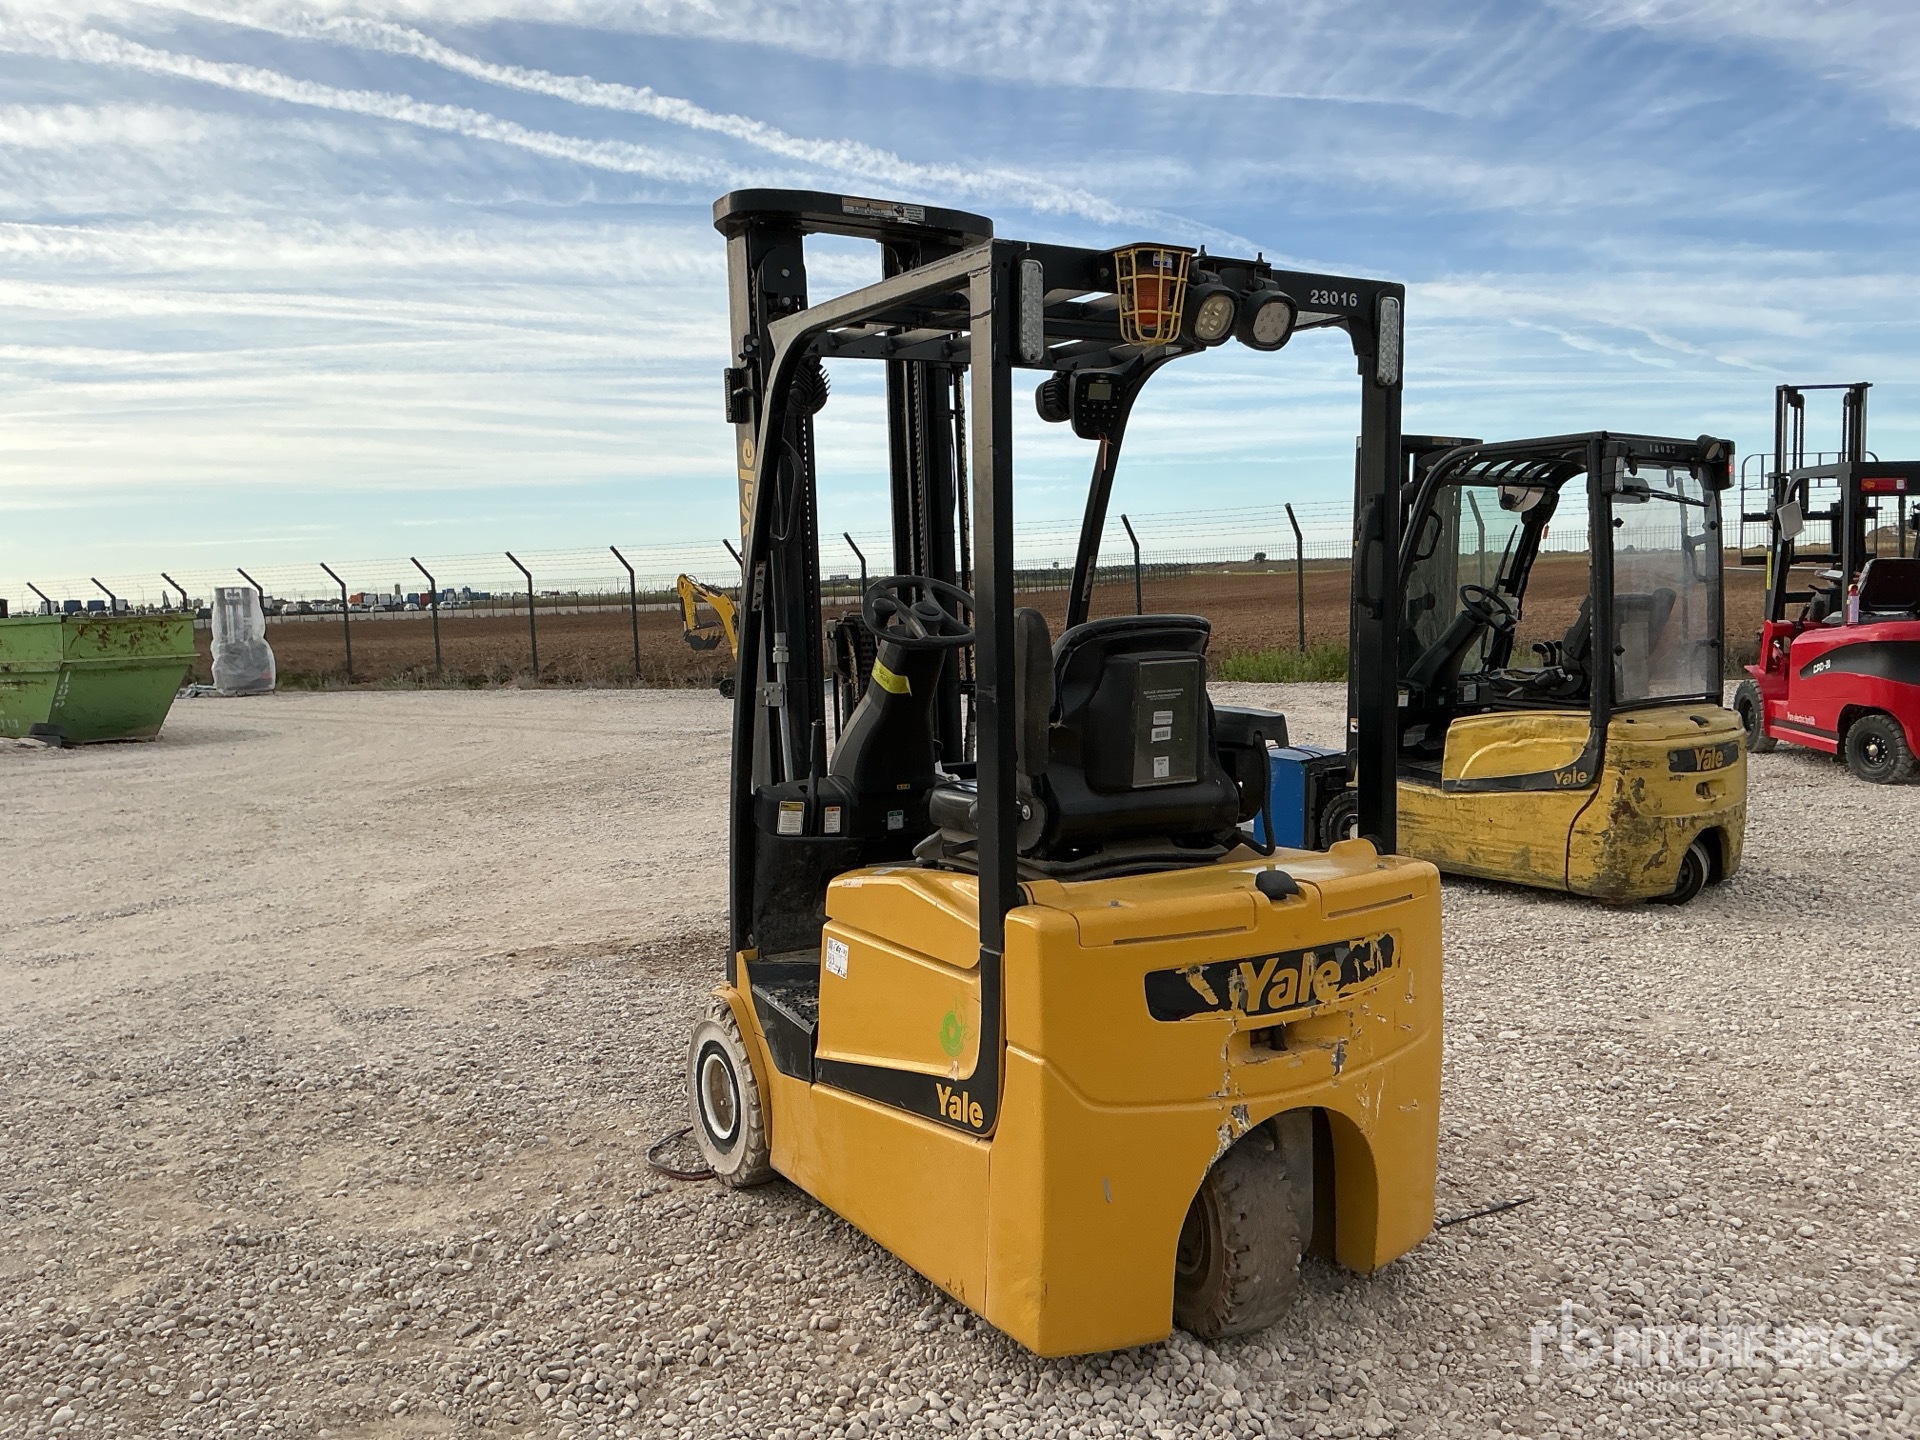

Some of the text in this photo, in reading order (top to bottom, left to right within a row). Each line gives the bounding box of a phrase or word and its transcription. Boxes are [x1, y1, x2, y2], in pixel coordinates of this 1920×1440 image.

[1310, 289, 1358, 307] 23016
[1694, 747, 1724, 771] Yale
[1553, 766, 1588, 786] Yale
[1238, 951, 1342, 1013] Yale
[935, 1082, 984, 1128] Yale
